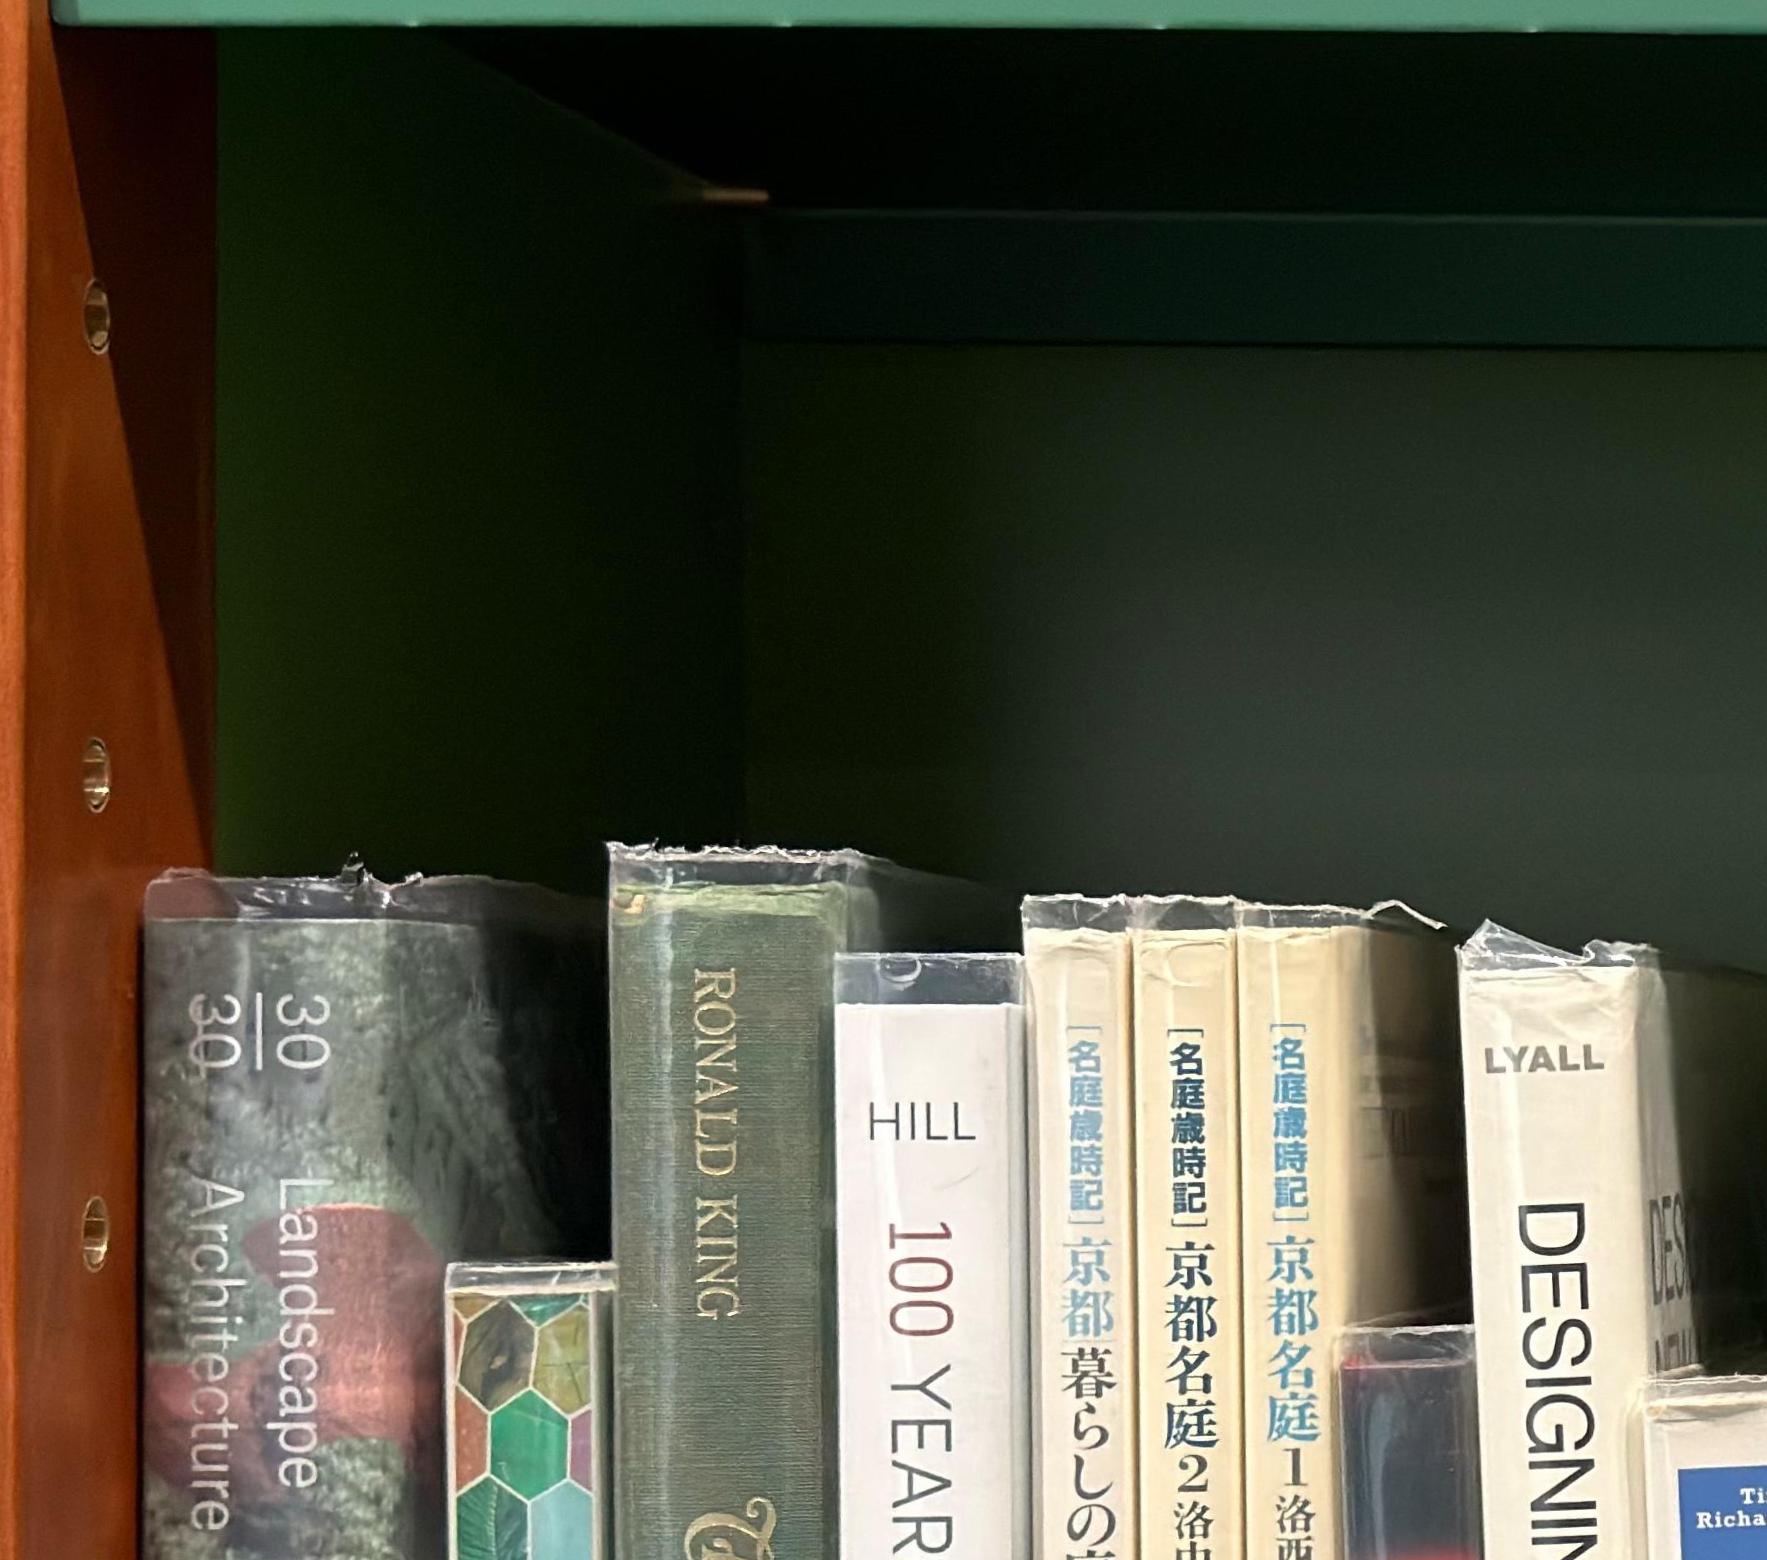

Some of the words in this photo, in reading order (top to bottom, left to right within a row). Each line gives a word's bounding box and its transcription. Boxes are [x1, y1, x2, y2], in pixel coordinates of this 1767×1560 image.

[188, 993, 241, 1070] 30
[276, 993, 331, 1070] 30
[694, 968, 739, 1177] RONALD
[1484, 1044, 1605, 1074] LYALL
[869, 1101, 976, 1141] HILL
[695, 1197, 742, 1321] KING
[888, 1221, 955, 1337] 100
[190, 1176, 246, 1532] Architecture
[279, 1177, 334, 1489] Landscape
